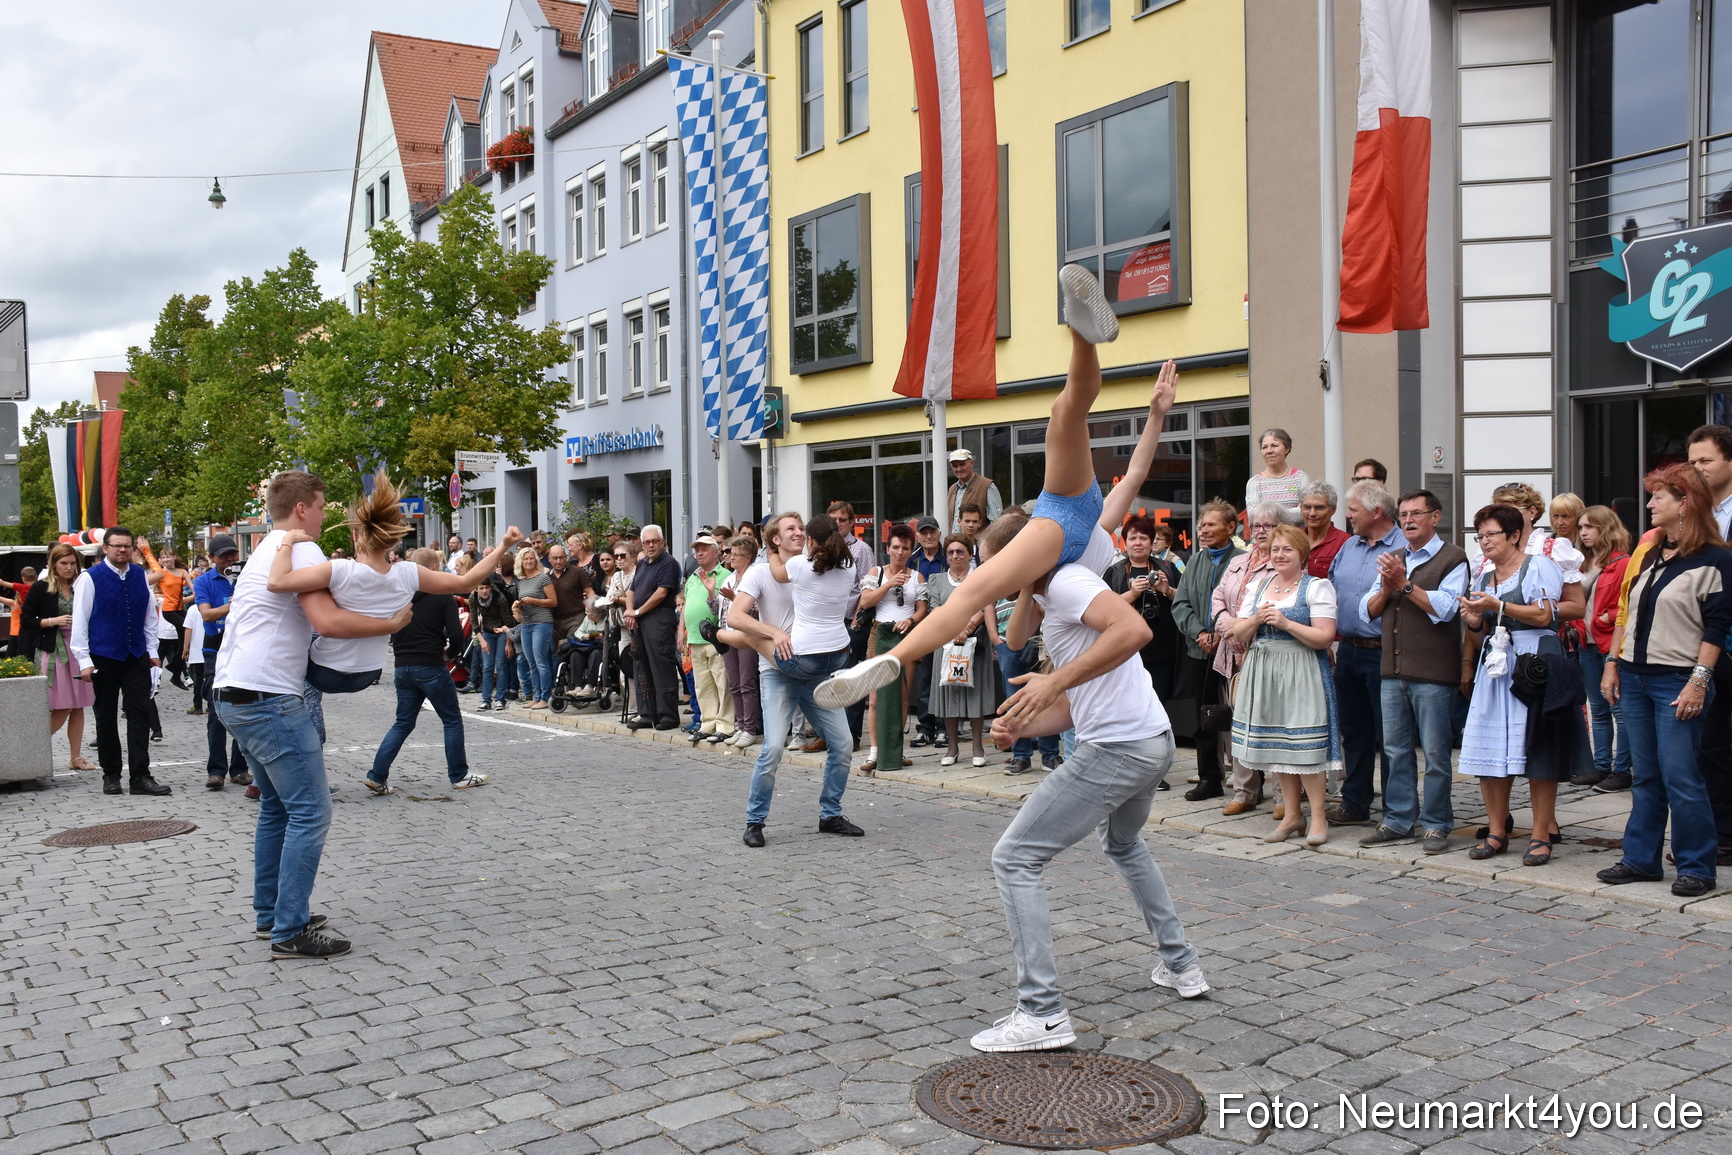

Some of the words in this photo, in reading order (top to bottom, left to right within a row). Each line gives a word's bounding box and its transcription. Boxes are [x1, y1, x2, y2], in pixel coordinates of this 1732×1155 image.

[1649, 258, 1713, 338] G2
[763, 404, 772, 420] 2
[582, 424, 662, 456] Raiffeisenbank
[953, 666, 964, 676] M
